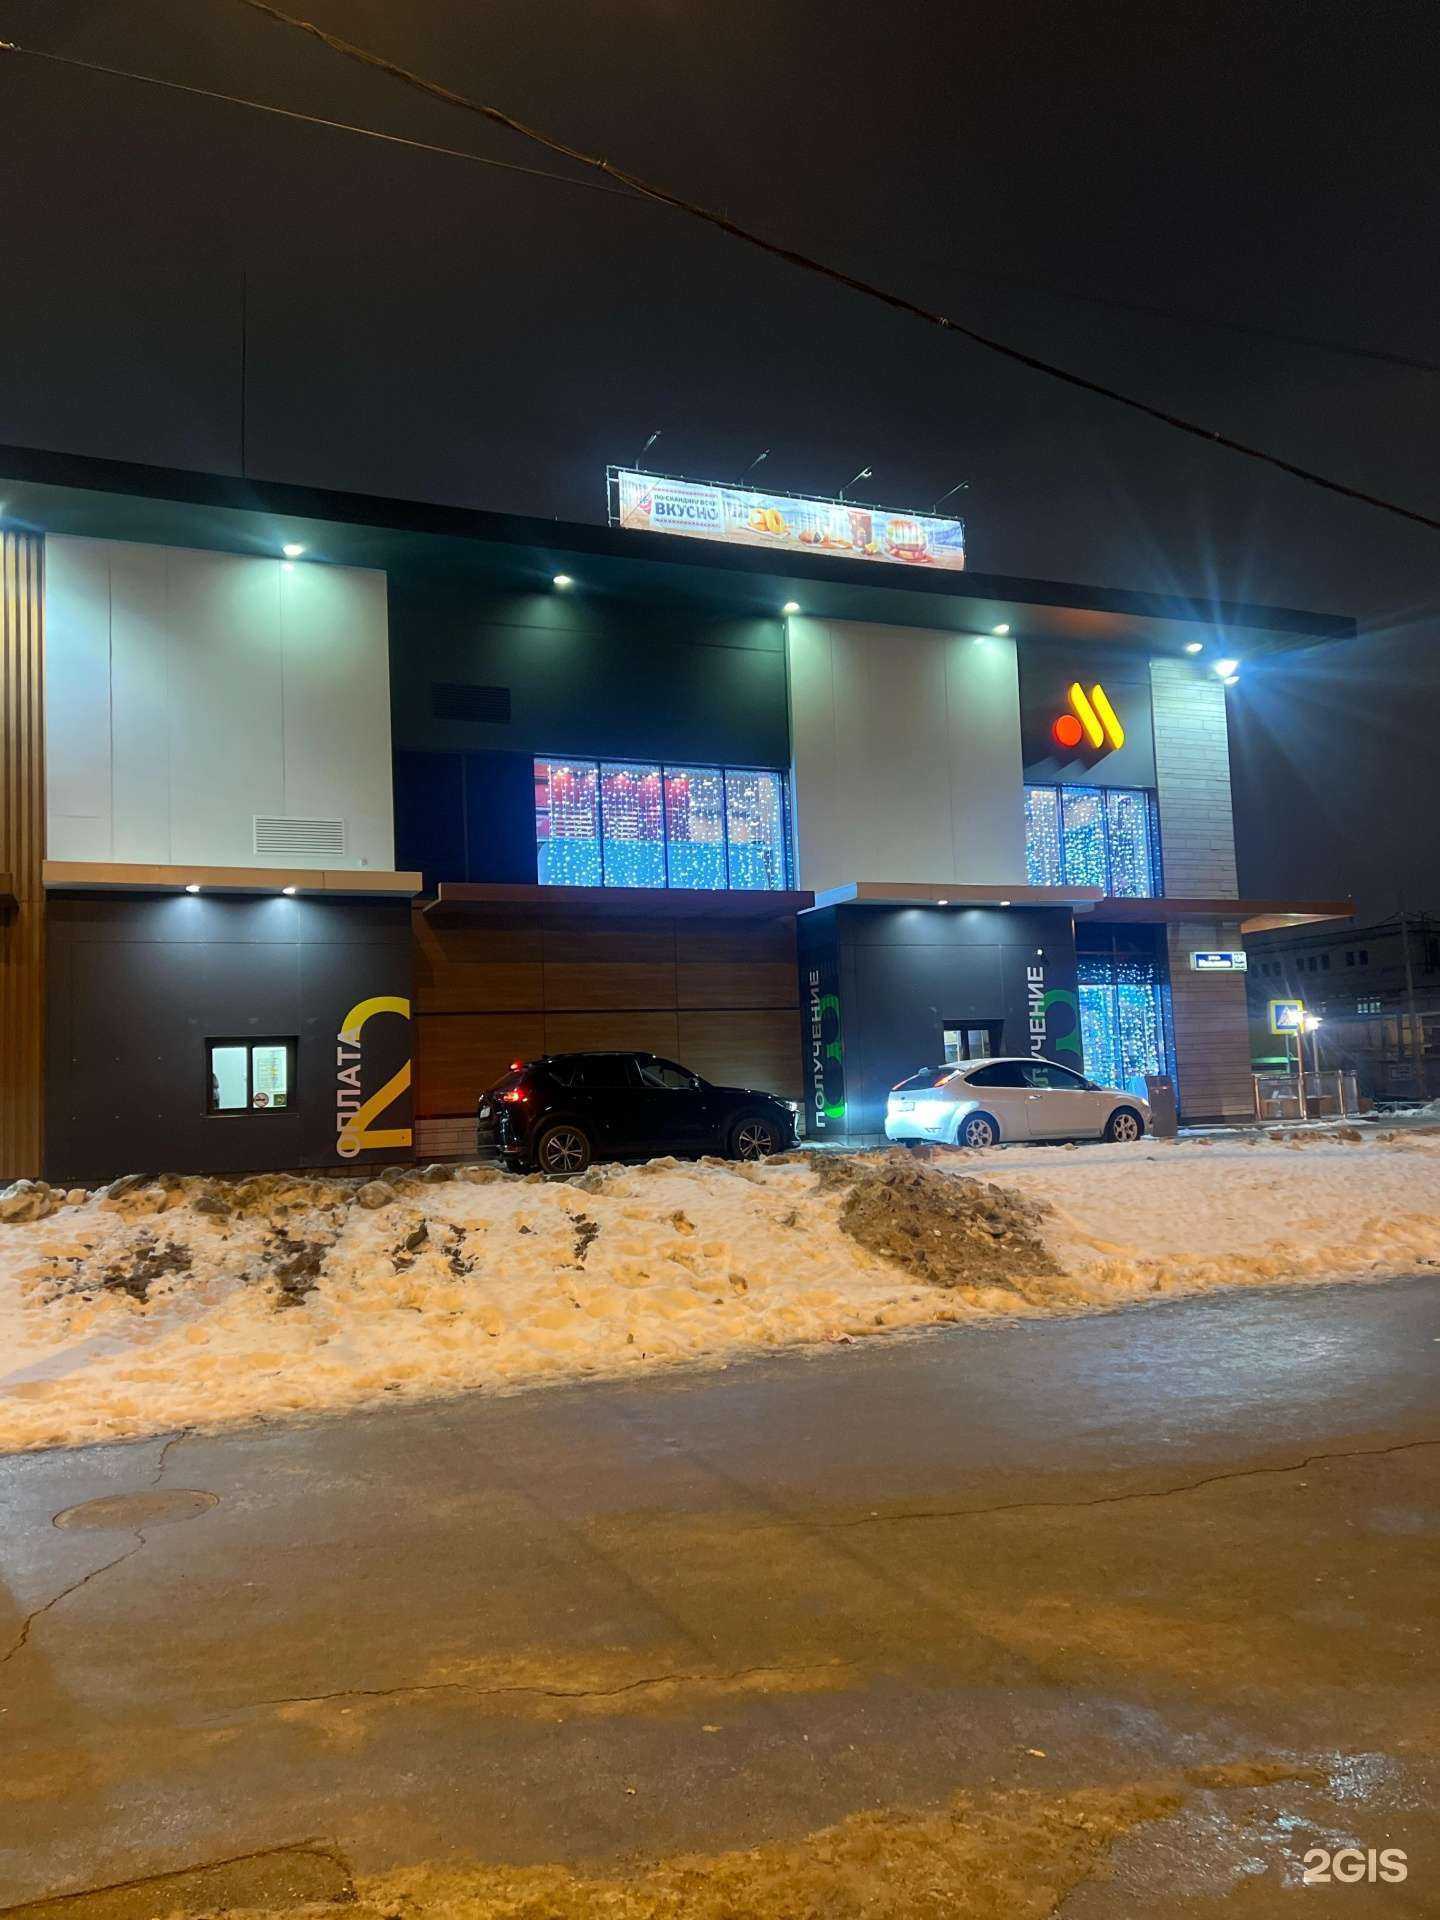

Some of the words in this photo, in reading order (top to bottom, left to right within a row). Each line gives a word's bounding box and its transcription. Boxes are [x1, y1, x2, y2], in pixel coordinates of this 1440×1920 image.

[655, 502, 719, 521] ВКУСНО
[336, 1025, 361, 1158] ОПЛАТА
[339, 996, 413, 1150] 2
[809, 970, 826, 1128] ПОЛУЧЕНИЕ
